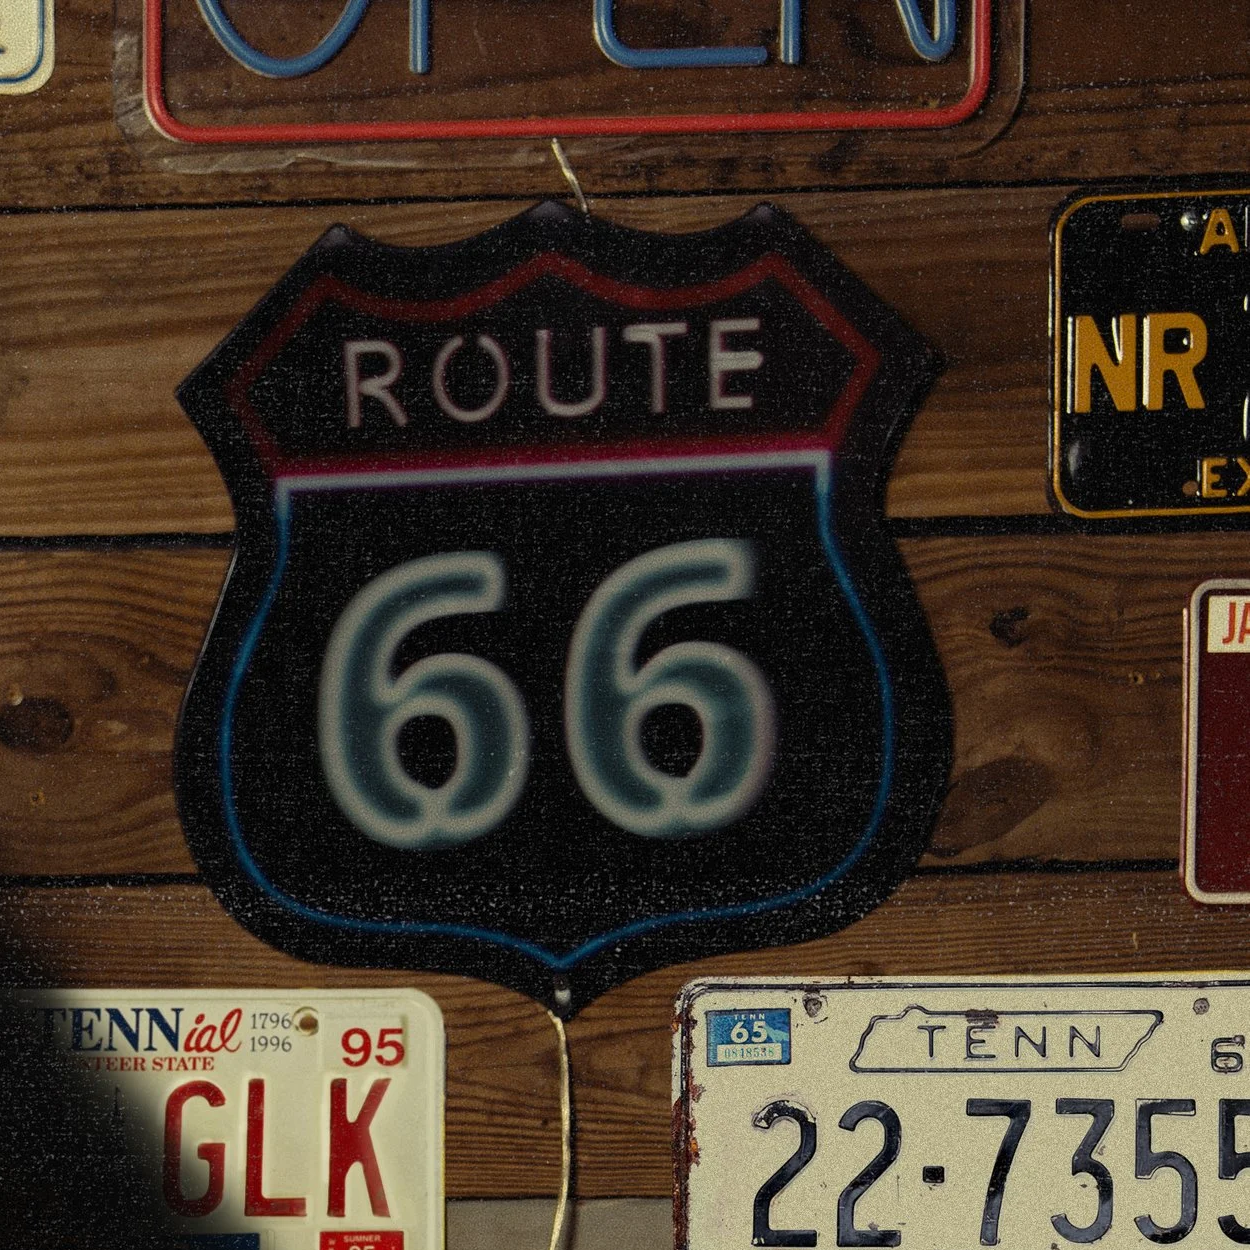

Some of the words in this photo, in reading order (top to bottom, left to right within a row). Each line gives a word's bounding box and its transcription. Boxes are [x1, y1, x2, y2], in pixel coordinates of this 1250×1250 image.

[343, 317, 766, 430] ROUTE
[317, 537, 778, 851] 66
[250, 1013, 292, 1030] 1796
[730, 1020, 768, 1043] 65
[250, 1037, 293, 1052] 1996
[342, 1028, 405, 1067] 95
[918, 1024, 1102, 1060] TENN
[151, 1057, 215, 1071] STATE
[162, 1078, 392, 1217] GLK
[343, 1234, 381, 1243] SUMNER
